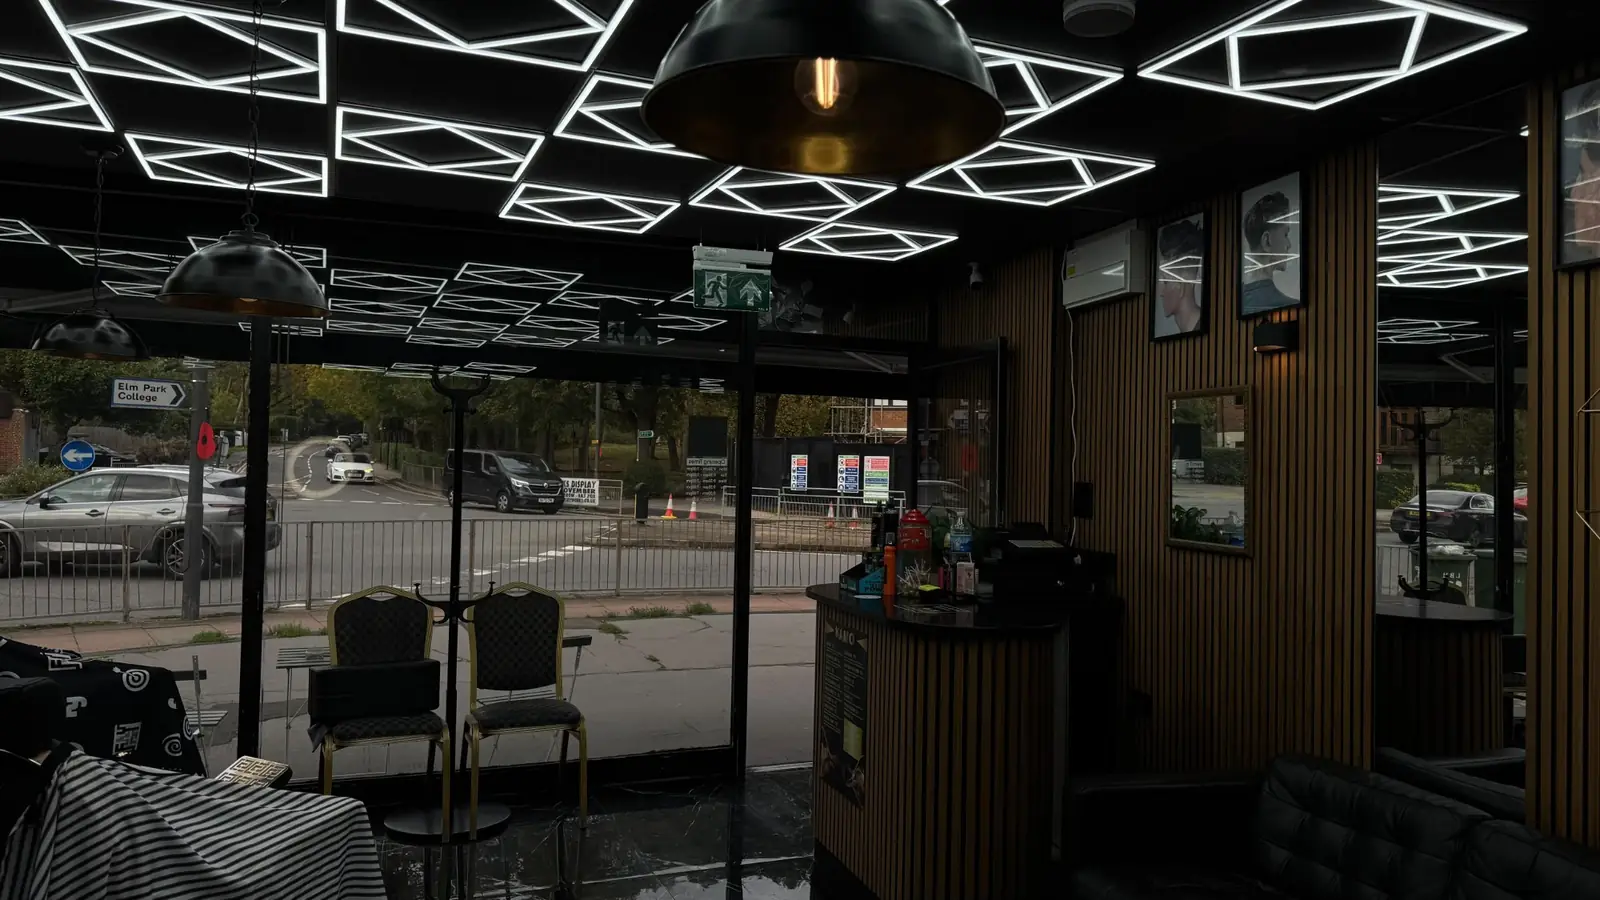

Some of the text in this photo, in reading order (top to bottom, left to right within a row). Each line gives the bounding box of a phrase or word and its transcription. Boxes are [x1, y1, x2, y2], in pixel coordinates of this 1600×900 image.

[118, 383, 167, 393] Elm Park
[118, 392, 157, 402] College
[571, 480, 597, 488] DISPLAY
